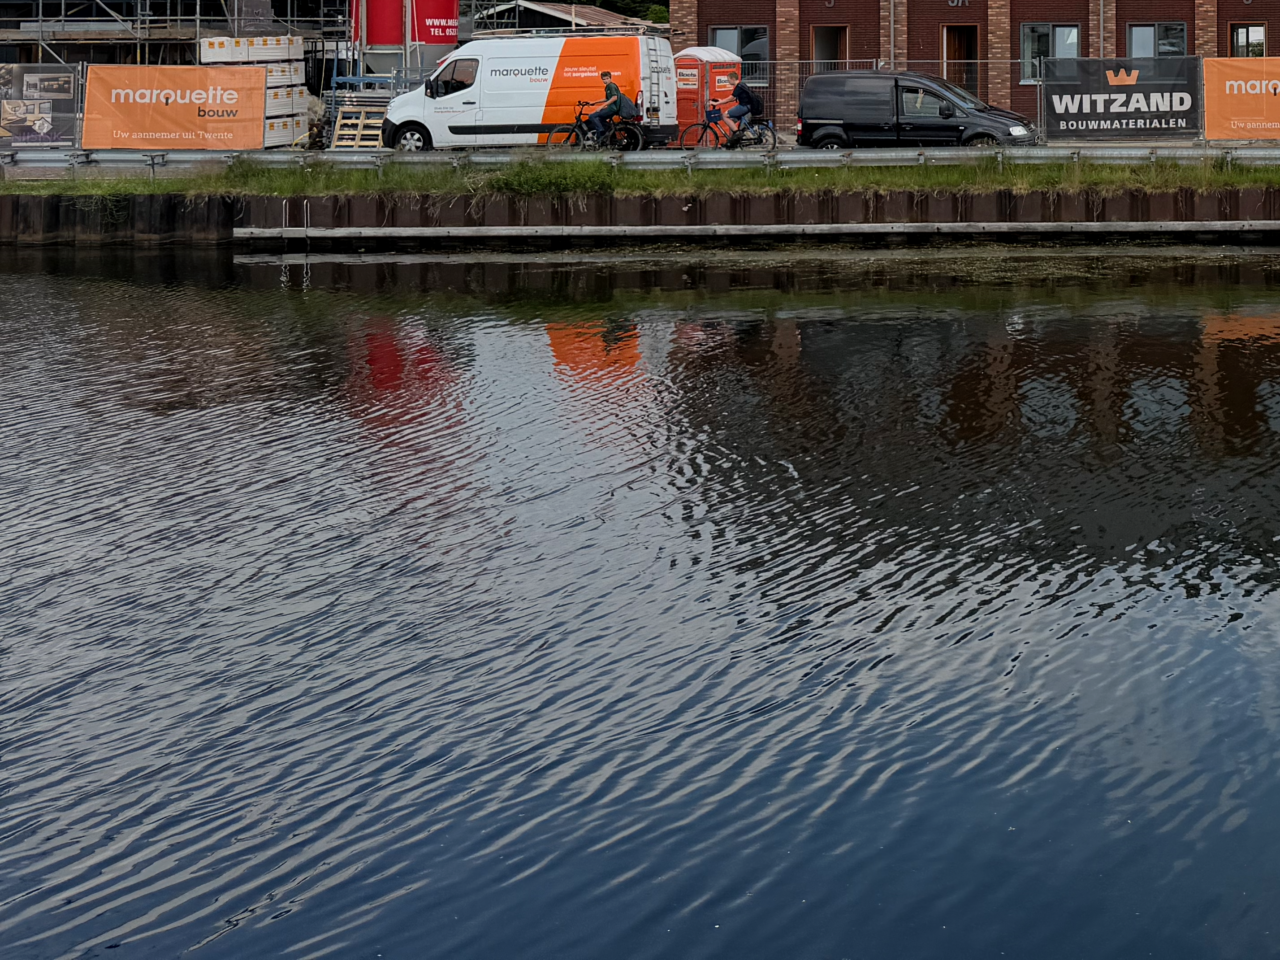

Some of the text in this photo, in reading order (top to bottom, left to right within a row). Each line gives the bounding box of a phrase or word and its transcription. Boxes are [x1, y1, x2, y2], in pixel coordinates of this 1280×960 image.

[430, 28, 445, 36] TEL.
[490, 66, 549, 78] marquette
[111, 86, 239, 106] marquette
[1051, 91, 1192, 114] WITZAND
[197, 106, 239, 118] bouw
[1059, 118, 1187, 130] BOUWMATERIALEN
[1230, 120, 1245, 129] Uw
[113, 130, 233, 139] Uw aannemer uit Twente
